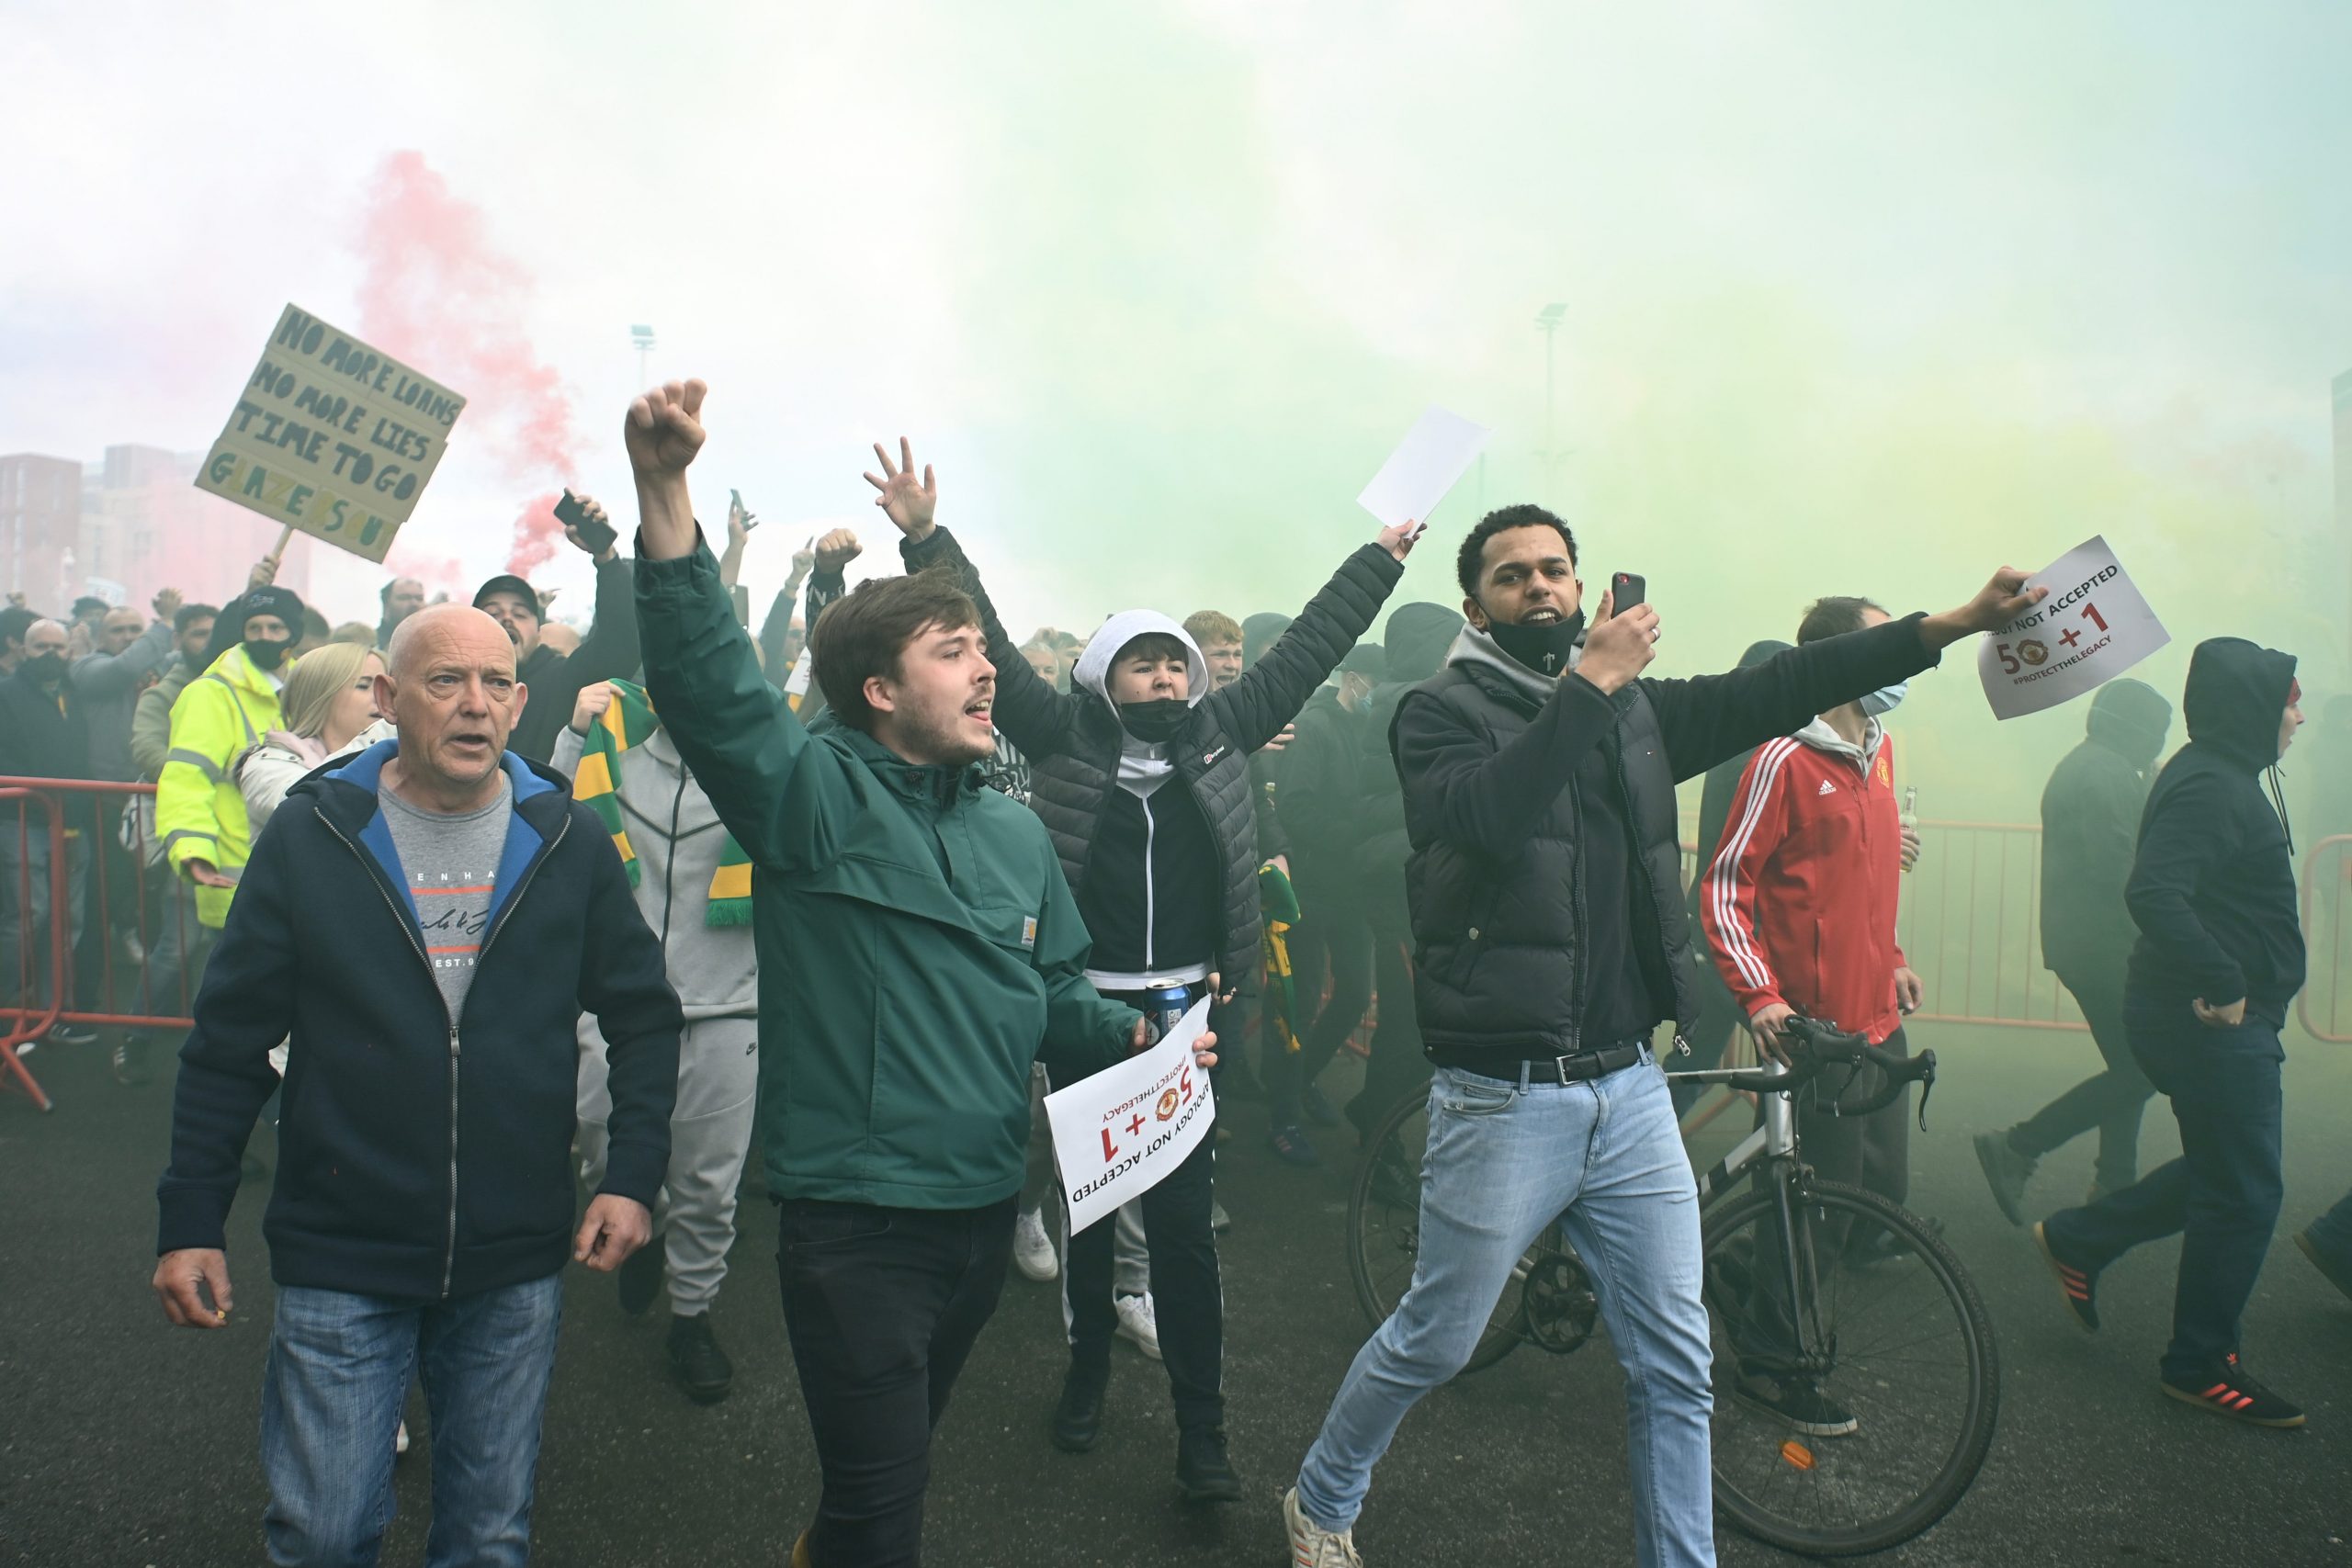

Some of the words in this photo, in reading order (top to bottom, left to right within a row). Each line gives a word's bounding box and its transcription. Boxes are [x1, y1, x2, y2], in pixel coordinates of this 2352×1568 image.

[277, 310, 325, 355] NO
[320, 337, 395, 393] MORE
[392, 374, 461, 426] LOANS
[253, 361, 295, 399] NO
[294, 385, 367, 434] MORE
[370, 417, 431, 462] LIES
[235, 400, 329, 464] TIME
[333, 441, 374, 485] TO
[374, 464, 417, 501] GO
[2014, 611, 2044, 632] NOT
[2049, 565, 2118, 617] ACCEPTED
[2013, 634, 2111, 685] #PROTECTTHELEGACY
[1175, 1079, 1209, 1135] APOLOGY
[1146, 1130, 1171, 1157] NOT
[1072, 1151, 1141, 1202] ACCEPTED
